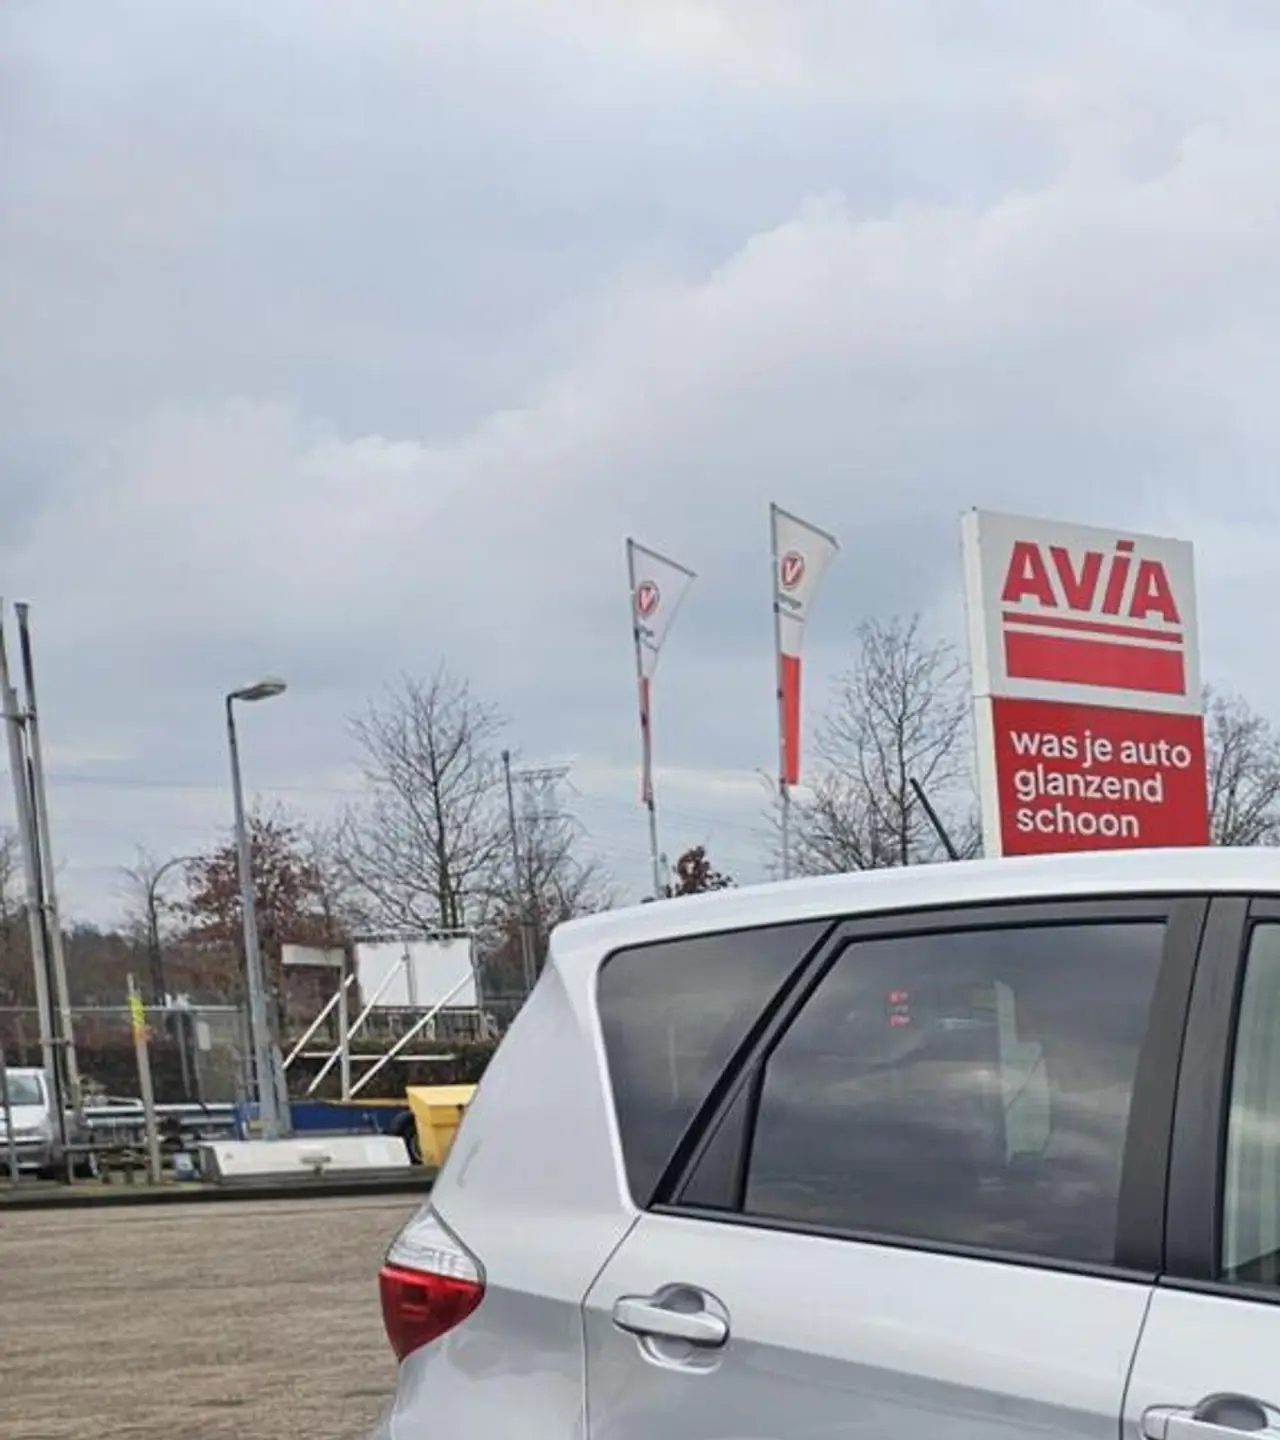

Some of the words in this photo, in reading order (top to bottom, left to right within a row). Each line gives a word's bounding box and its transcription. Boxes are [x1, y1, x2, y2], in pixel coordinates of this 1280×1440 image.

[1010, 731, 1078, 760] was
[1082, 730, 1113, 768] je
[1120, 741, 1192, 768] auto
[1014, 764, 1163, 803] glanzend
[1016, 803, 1140, 838] schoon
